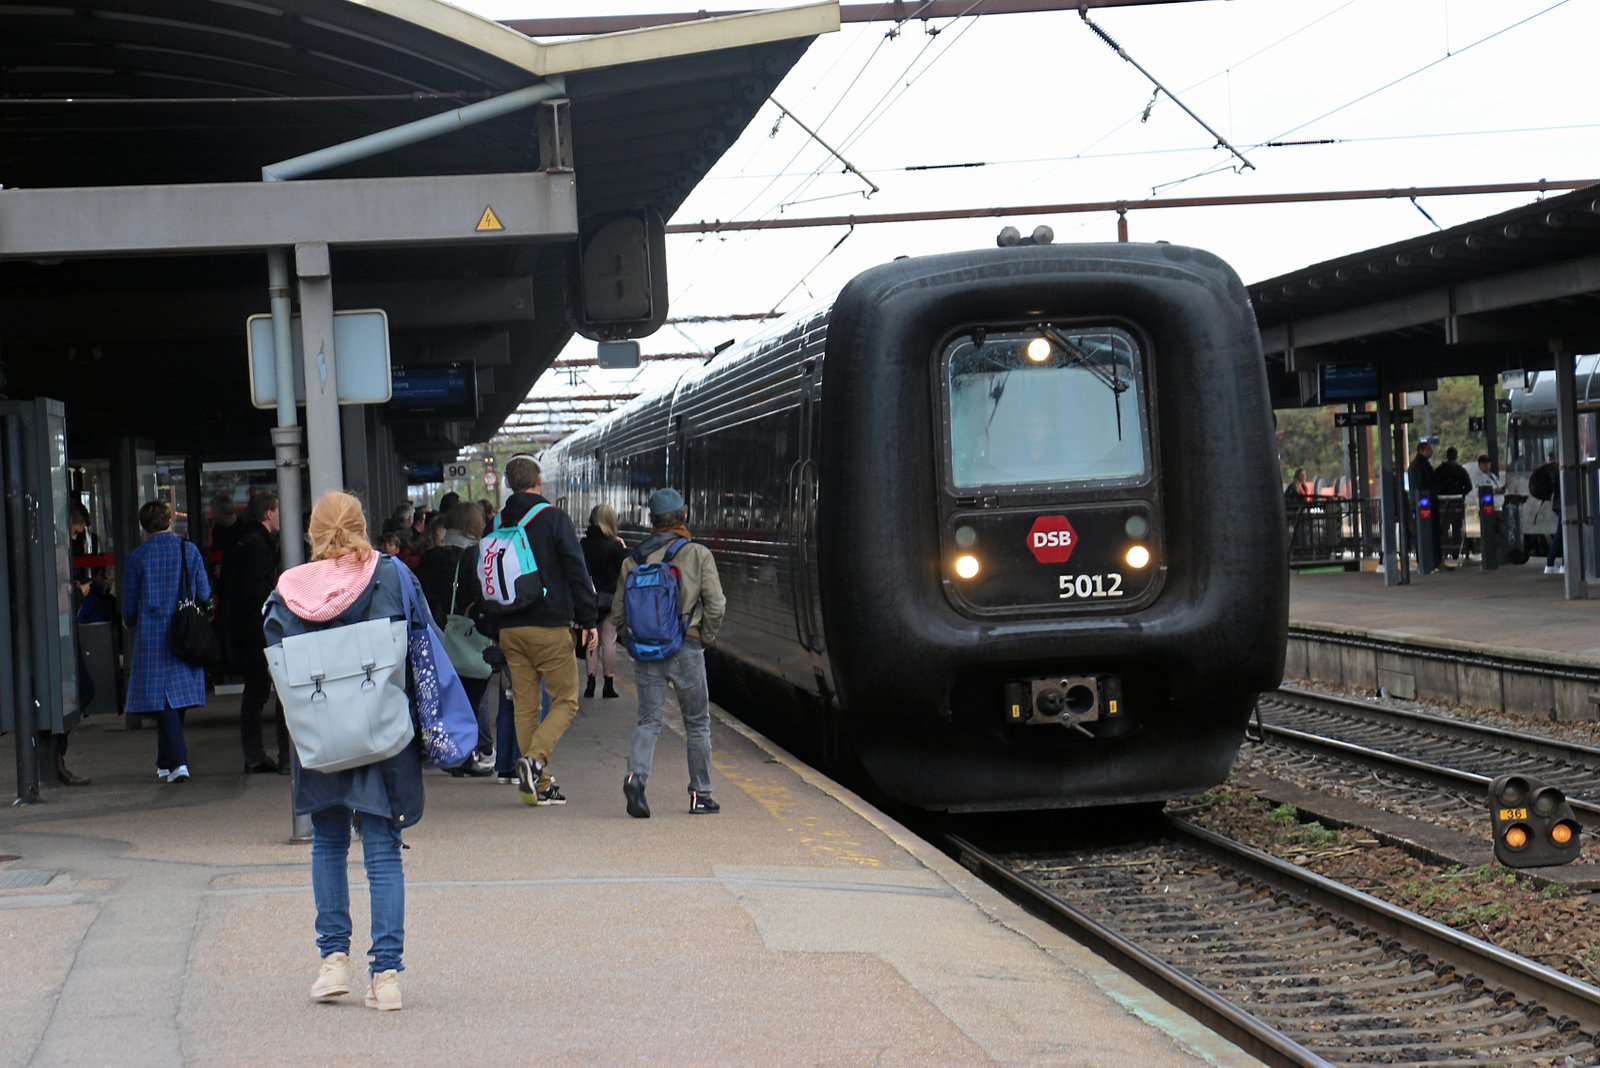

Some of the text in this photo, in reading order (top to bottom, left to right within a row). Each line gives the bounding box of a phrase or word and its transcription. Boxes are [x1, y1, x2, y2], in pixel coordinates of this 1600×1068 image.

[449, 466, 466, 477] 90
[1033, 530, 1072, 548] DSB
[1059, 573, 1123, 599] 5012
[1507, 810, 1522, 819] 36
